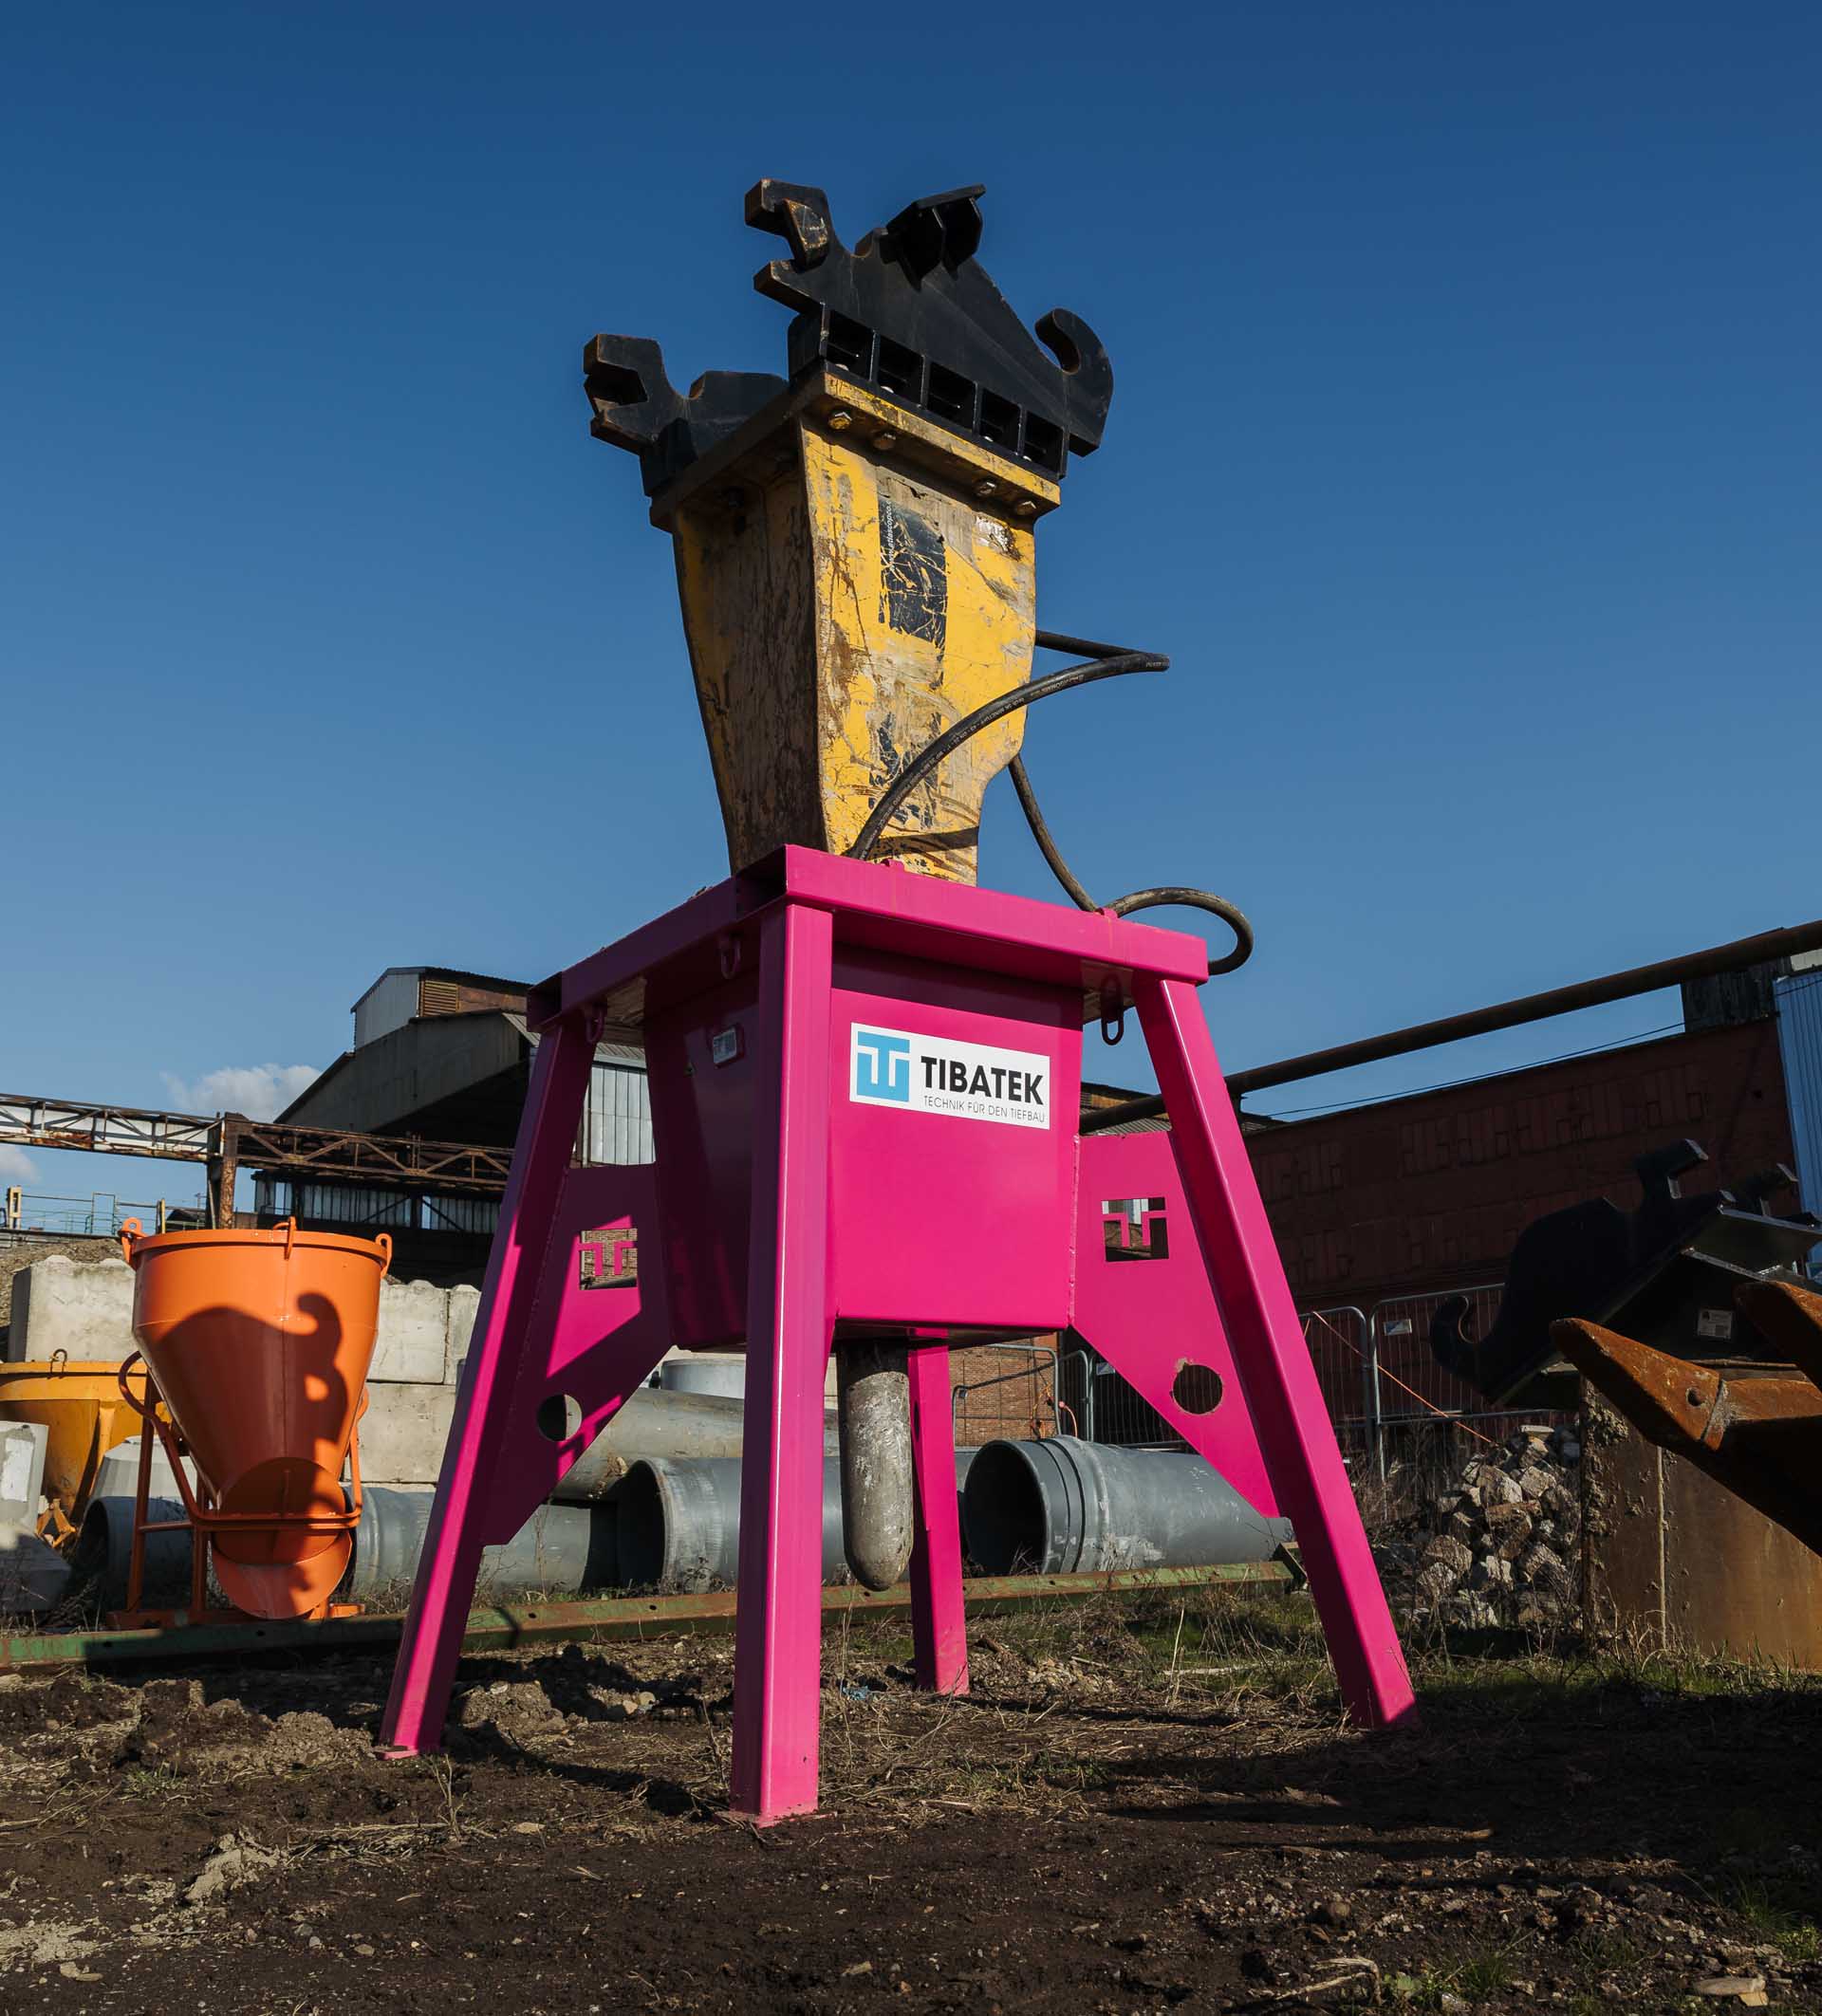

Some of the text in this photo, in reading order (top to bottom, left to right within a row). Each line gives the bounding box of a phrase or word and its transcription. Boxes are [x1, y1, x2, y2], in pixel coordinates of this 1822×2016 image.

[920, 1055, 1044, 1105] TIBATEK
[923, 1095, 1045, 1122] TECHNIK FÜR DEN TIEFBAU
